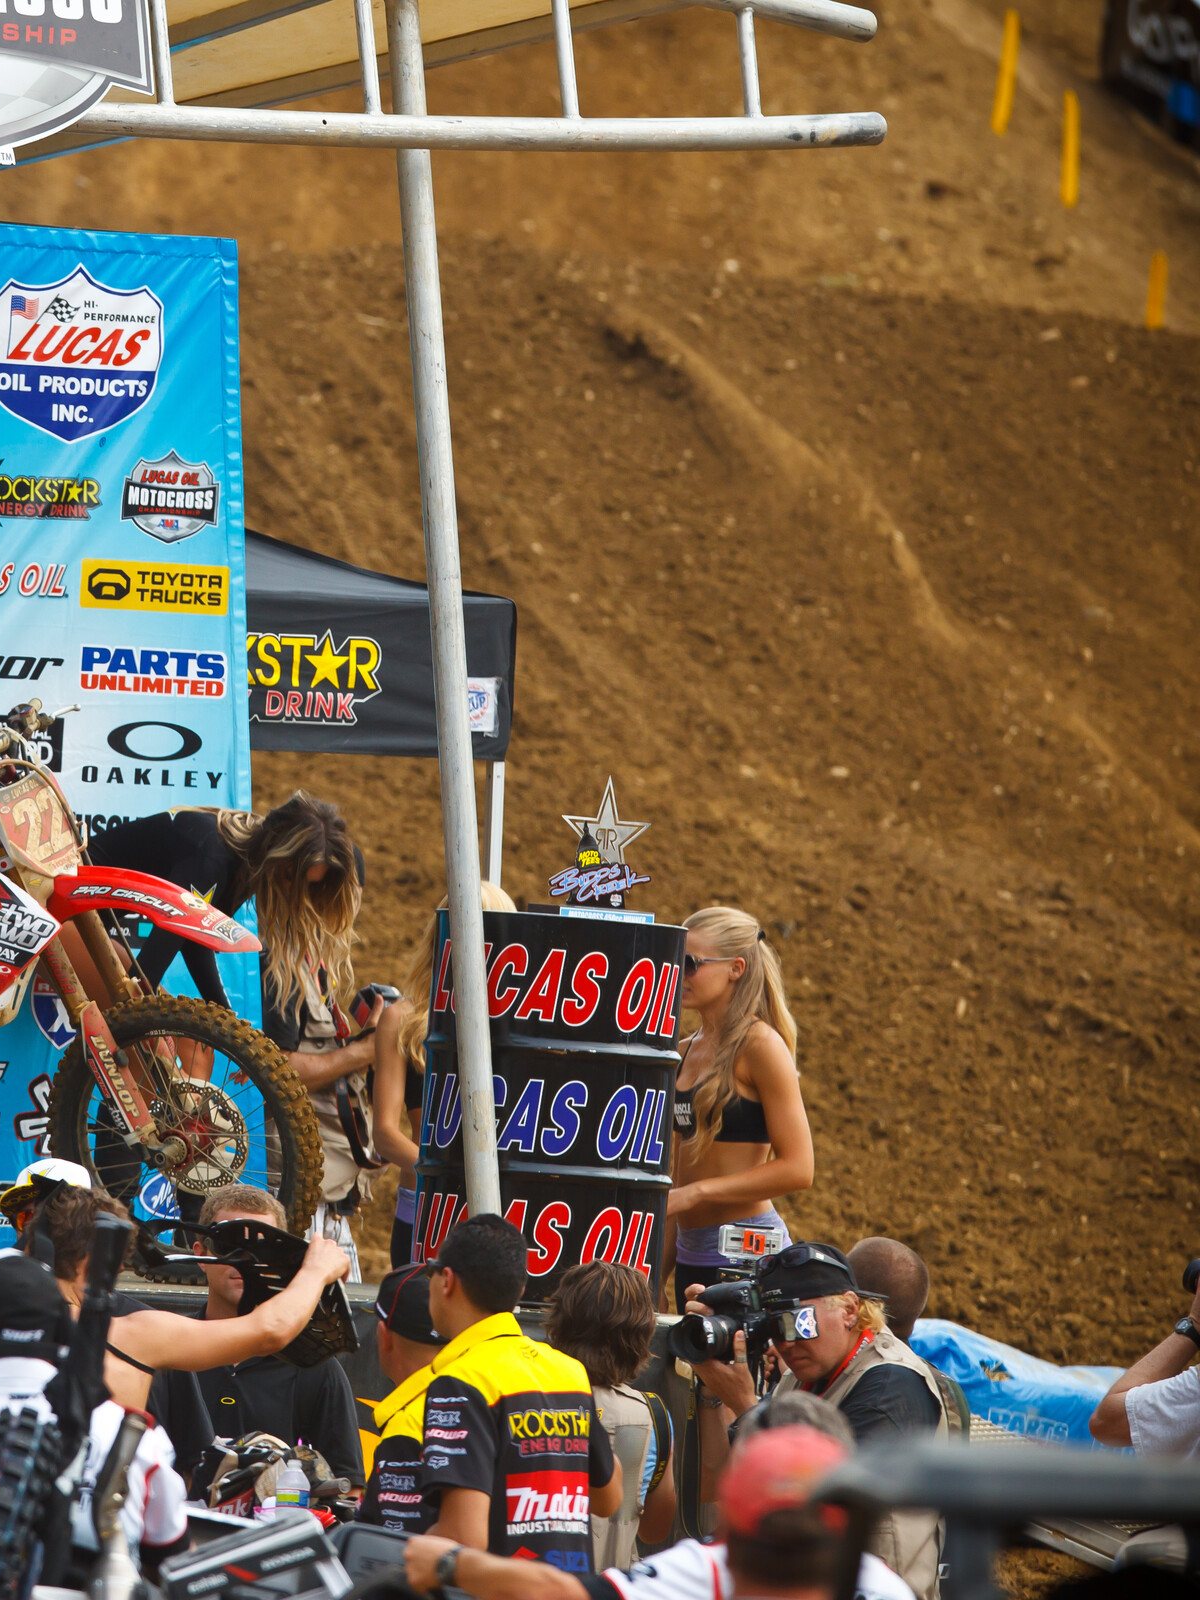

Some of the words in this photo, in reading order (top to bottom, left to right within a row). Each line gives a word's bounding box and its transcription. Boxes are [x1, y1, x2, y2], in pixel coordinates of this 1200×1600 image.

[84, 312, 156, 324] PERFORMANCE
[6, 323, 151, 367] LUCAS
[38, 375, 148, 397] PRODUCTS
[51, 404, 94, 424] INC.
[141, 469, 178, 484] LUCAS
[181, 472, 200, 486] OIL
[128, 485, 214, 510] MOTOCROSS
[50, 504, 89, 518] DRINK
[138, 506, 201, 516] CHAMPIONSHIP
[19, 562, 68, 598] OIL
[137, 570, 223, 589] TOYOTA
[136, 588, 221, 606] TRUCKS
[81, 646, 226, 680] PARTS
[80, 673, 225, 697] UNLIMITED
[264, 690, 355, 720] DRINK
[82, 766, 225, 789] OAKLEY
[11, 785, 75, 863] 22
[579, 850, 599, 862] MOTO
[581, 857, 600, 868] TEES
[73, 885, 111, 896] PRO
[110, 888, 188, 917] CIRCUIT
[615, 957, 681, 1039] OIL
[91, 1035, 142, 1119] DUNLOP
[596, 1084, 667, 1165] OIL
